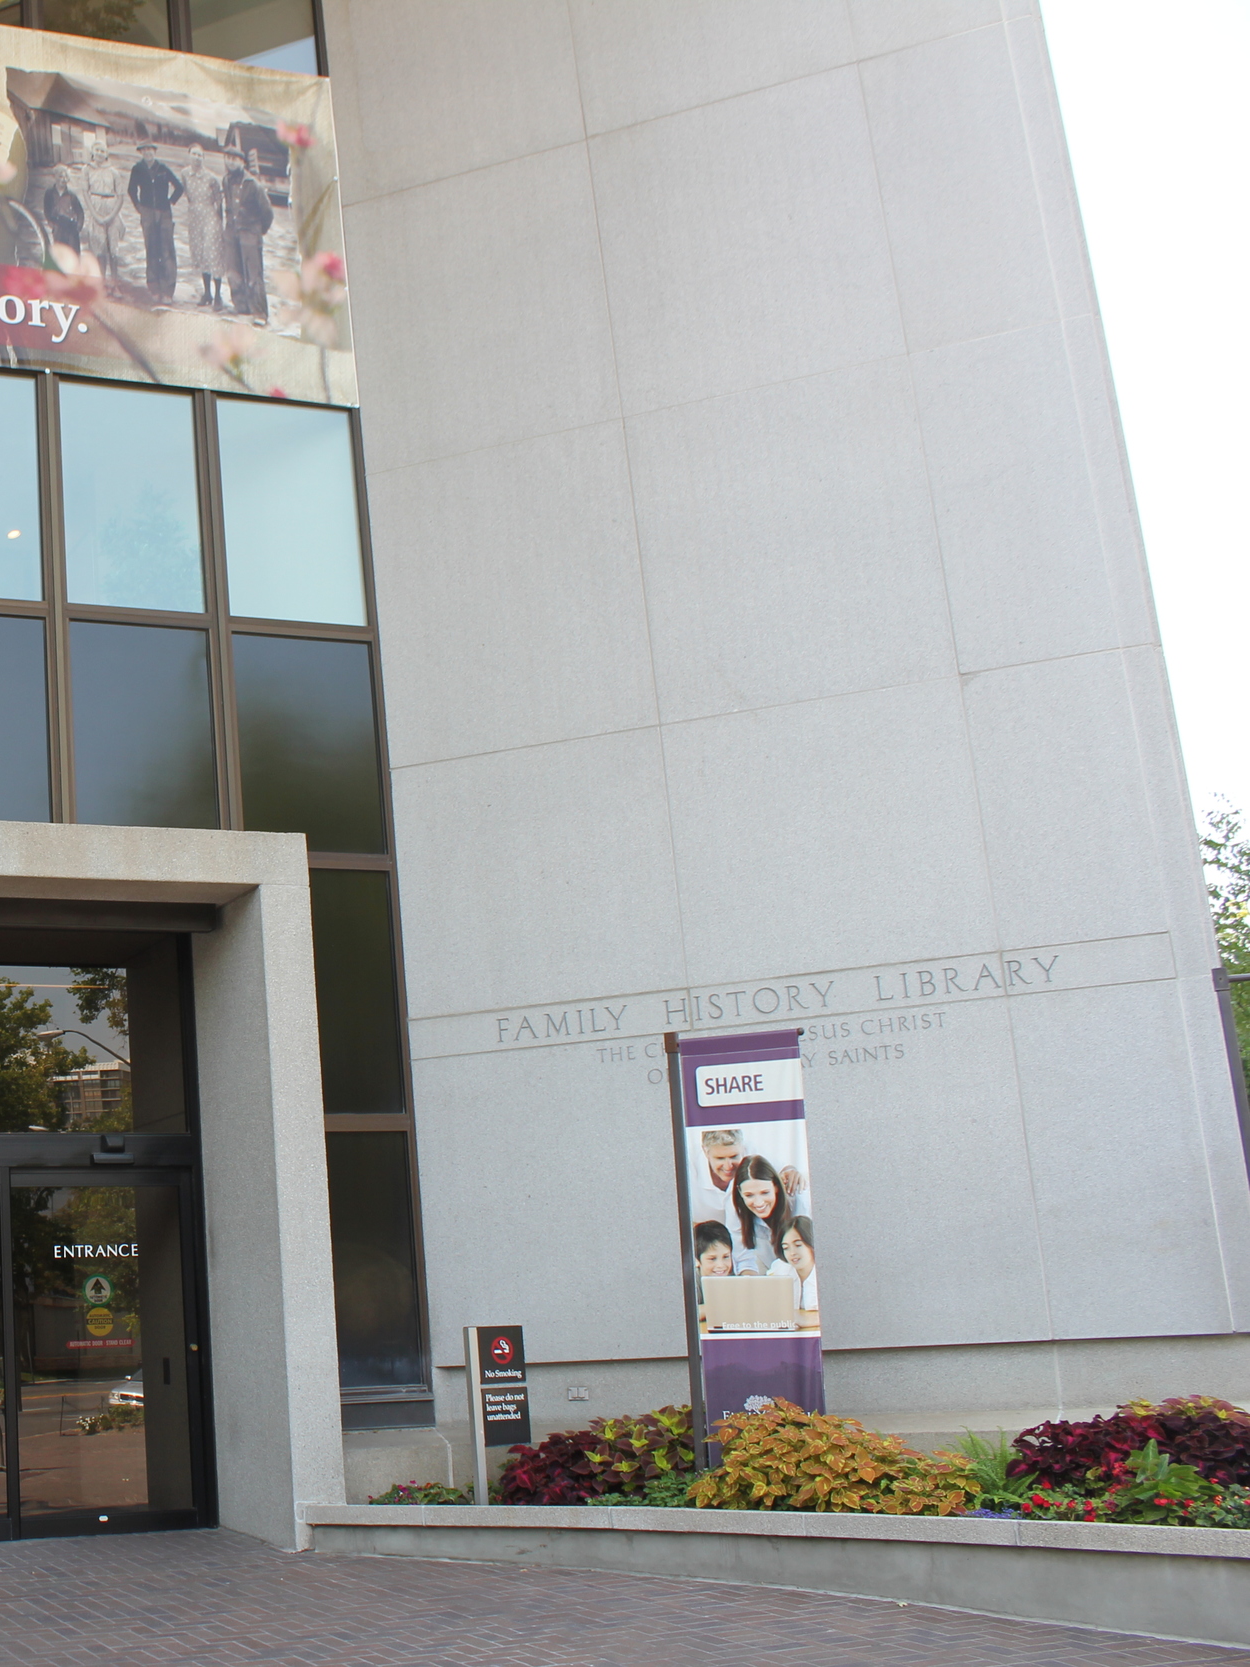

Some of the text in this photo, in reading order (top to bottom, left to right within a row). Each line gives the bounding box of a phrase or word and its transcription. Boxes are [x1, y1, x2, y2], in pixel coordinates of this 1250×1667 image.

[496, 955, 1060, 1043] FAMILY HISTORY LIBRARY
[596, 1045, 636, 1063] THE
[860, 1011, 947, 1035] CHRIST
[828, 1043, 905, 1067] SAINTS
[704, 1074, 764, 1095] SHARE
[53, 1243, 139, 1259] ENTRANCE
[721, 1321, 740, 1329] Free
[742, 1321, 751, 1329] to
[484, 1369, 522, 1379] No Smoking
[485, 1394, 505, 1402] Please
[505, 1393, 513, 1401] do
[486, 1403, 517, 1412] leave bags
[486, 1411, 522, 1421] unattended
